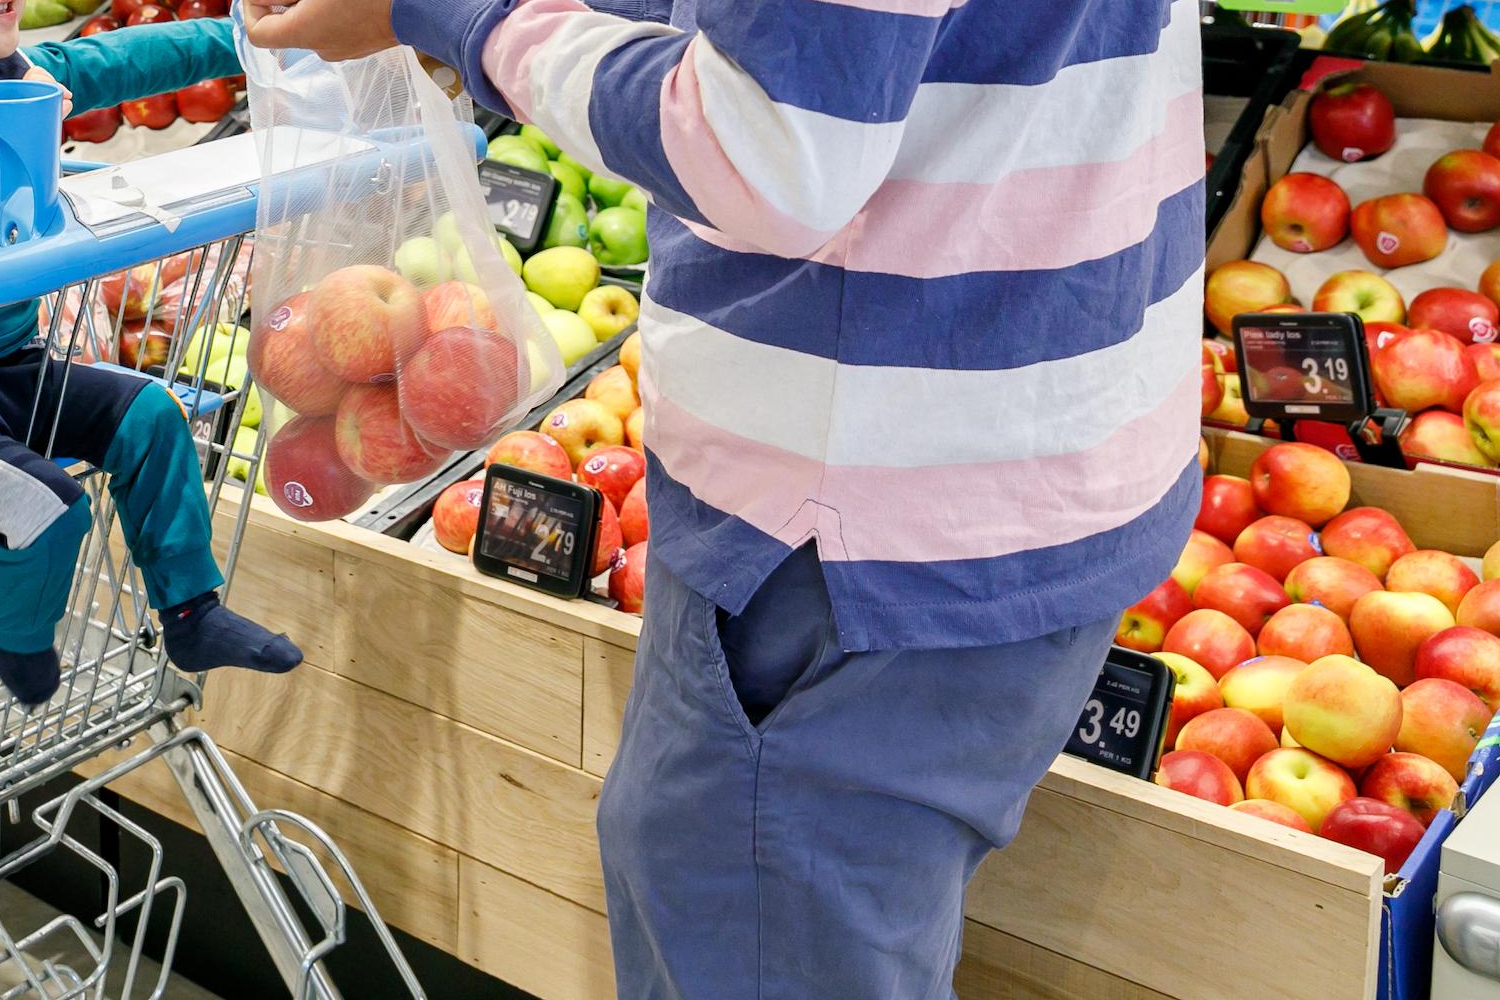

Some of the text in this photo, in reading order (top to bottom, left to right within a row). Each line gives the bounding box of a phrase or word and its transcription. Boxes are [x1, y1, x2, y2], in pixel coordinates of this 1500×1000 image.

[1265, 331, 1285, 340] lady
[1286, 331, 1301, 339] los
[493, 481, 537, 500] AH Fuji los
[1099, 750, 1114, 760] PER
[1121, 755, 1132, 765] KG
